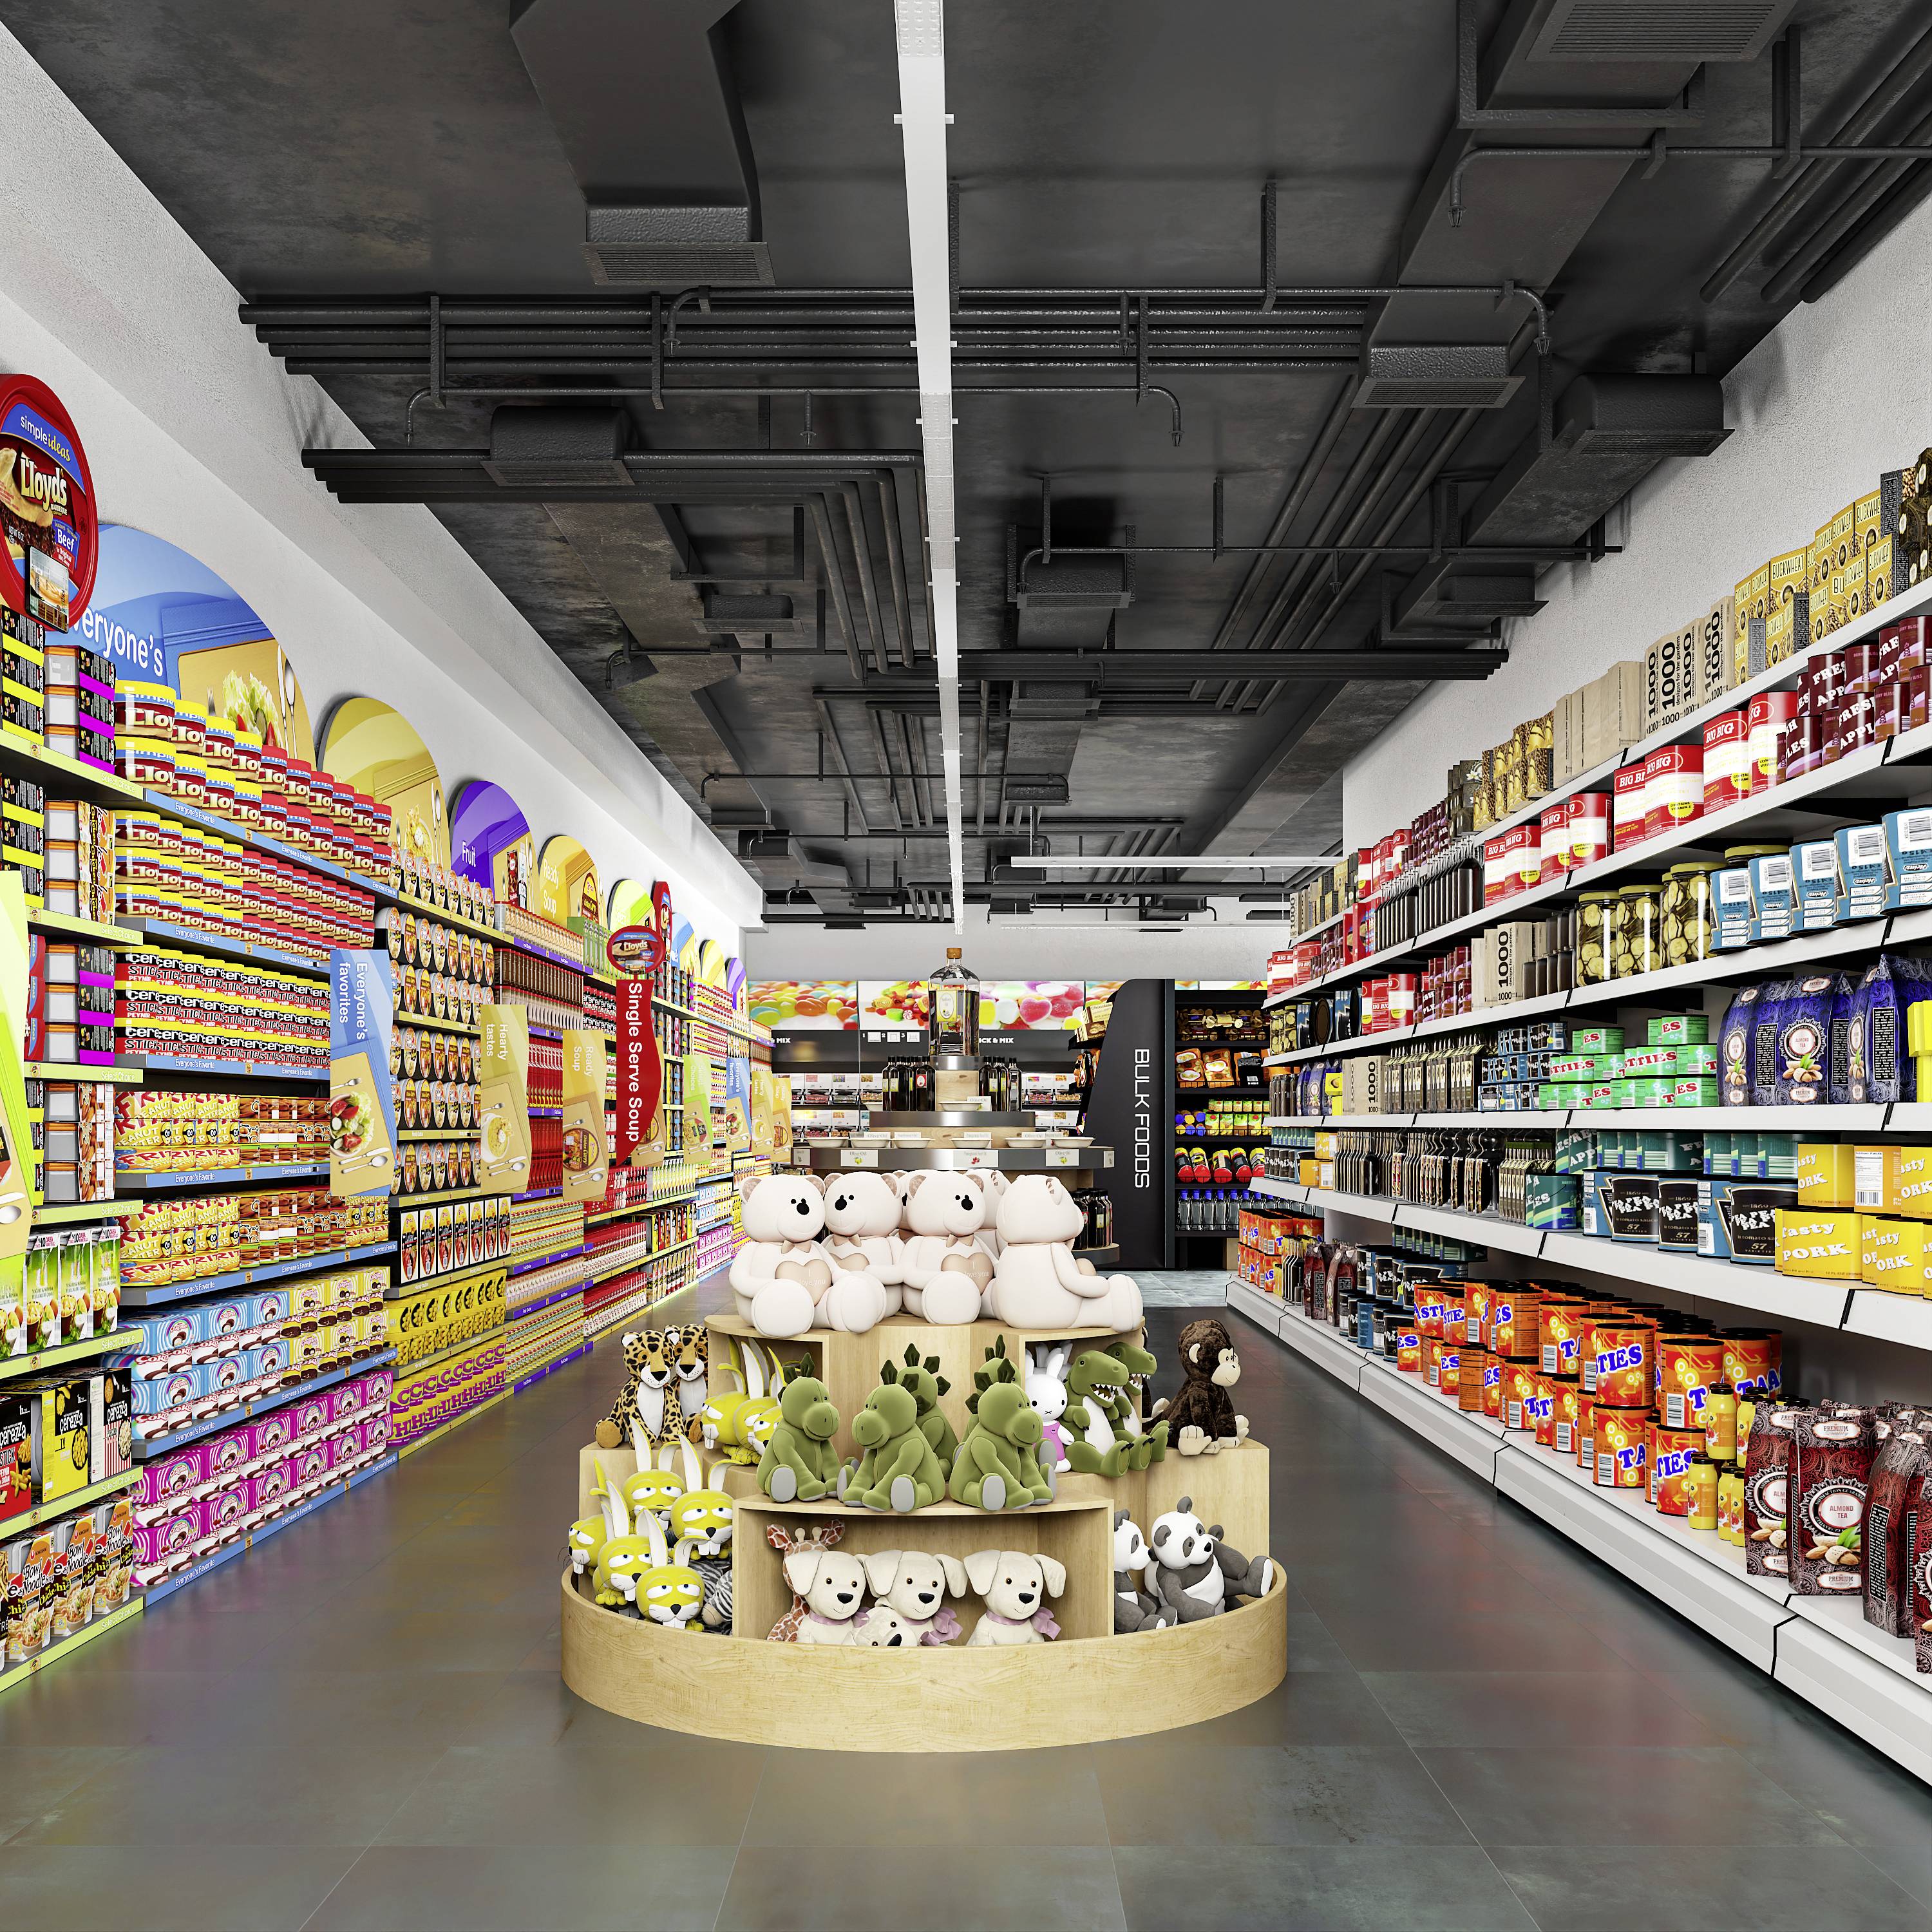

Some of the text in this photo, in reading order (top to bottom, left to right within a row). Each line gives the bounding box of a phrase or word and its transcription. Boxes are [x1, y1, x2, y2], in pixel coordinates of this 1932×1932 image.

[21, 415, 71, 462] simple ideas
[21, 458, 67, 511] Lloyd's
[51, 504, 68, 516] BARBEQUE
[1857, 497, 1880, 524] BUCKWHE
[1832, 511, 1852, 538] BUCKWHEAT
[57, 528, 74, 552] Beef
[1772, 555, 1804, 579] BUCKWHEAT
[1869, 542, 1891, 571] BUCKWHEAT
[1844, 558, 1865, 587] BUCKWHEAT
[1810, 587, 1829, 612] BUCKWHEAT
[73, 606, 164, 677] eryone's
[1711, 611, 1720, 684] 1000
[1662, 641, 1675, 710] 1000
[1683, 632, 1692, 702] 1000
[1812, 660, 1845, 686] FRES
[1648, 652, 1656, 719] 1000
[1711, 685, 1723, 699] 1000
[1649, 721, 1658, 734] 1000
[1662, 712, 1680, 726] 1000
[1706, 722, 1734, 743] BIG BIG
[1656, 755, 1671, 770] BIG
[102, 773, 135, 793] Select Choice
[1619, 772, 1645, 787] BIG BI
[175, 802, 215, 824] Everyone's Favorite
[462, 840, 477, 867] Fruit
[544, 858, 559, 889] Ready
[544, 890, 556, 918] Soup
[175, 927, 215, 943] Everyone's Favorite
[1498, 931, 1508, 987] 1000
[339, 962, 350, 1023] favorites
[354, 963, 368, 1040] Everyone's
[1498, 992, 1511, 1000] 1000
[486, 1024, 495, 1057] tastes
[498, 1024, 508, 1061] Hearty
[175, 1058, 215, 1069] Everyone's Favorite
[584, 1046, 593, 1077] Ready
[626, 983, 642, 1142] Single Serve Soup
[102, 1072, 135, 1081] Select Choice
[1135, 1048, 1150, 1188] BULK FOODS
[175, 1173, 215, 1184] Everyone's Favorite
[1799, 1173, 1828, 1189] ORK
[1783, 1244, 1852, 1261] PORK
[1877, 1255, 1914, 1272] ORK
[175, 1281, 215, 1296] Everyone's Favorite
[102, 1335, 135, 1350] Select Choice
[175, 1421, 215, 1443] Everyone's Favorite
[102, 1473, 135, 1492] Select Choice
[106, 1520, 123, 1540] Bowl
[68, 1539, 86, 1559] Bowl
[106, 1535, 126, 1555] Noodle
[23, 1557, 42, 1580] Bowl
[68, 1553, 89, 1575] Noodle
[175, 1559, 215, 1586] Everyone's Favorite
[23, 1575, 47, 1596] Noodle
[101, 1607, 135, 1629] Select Choice
